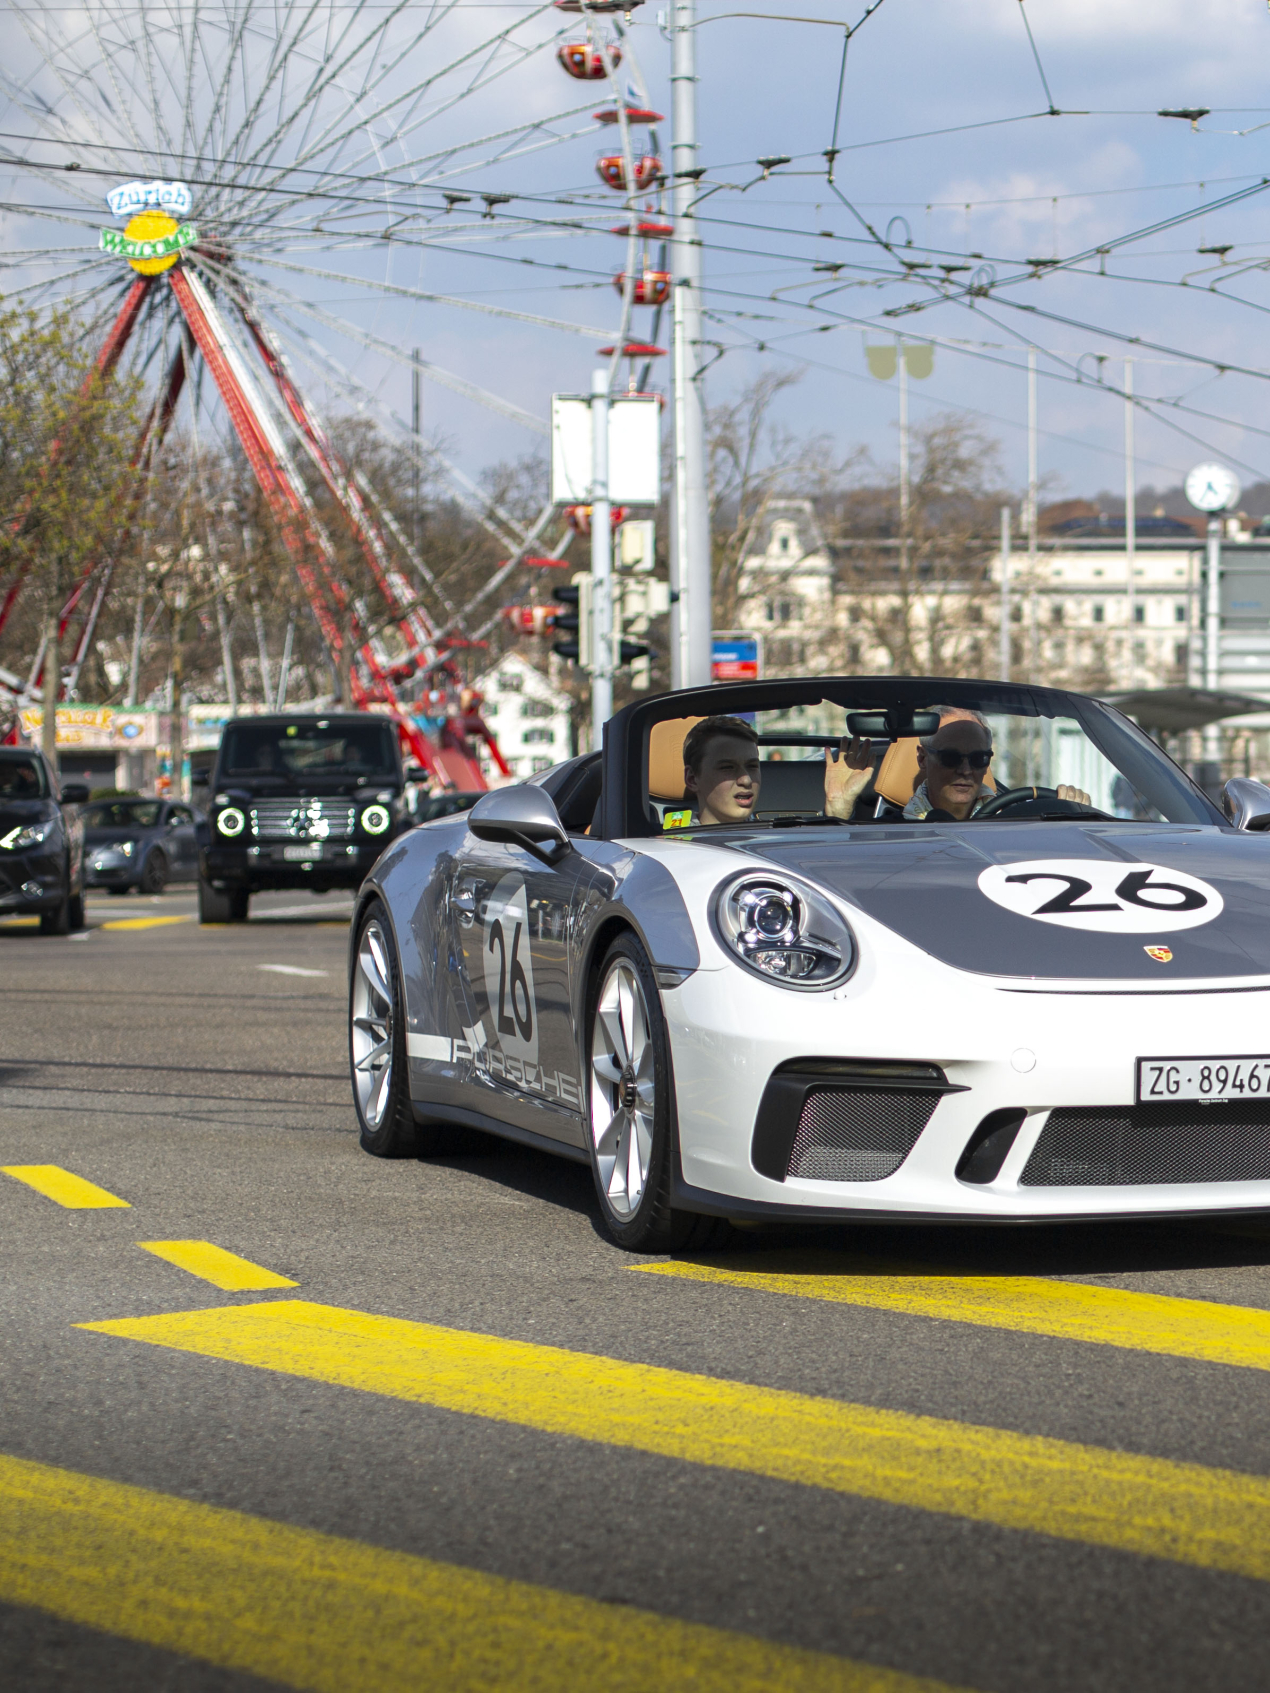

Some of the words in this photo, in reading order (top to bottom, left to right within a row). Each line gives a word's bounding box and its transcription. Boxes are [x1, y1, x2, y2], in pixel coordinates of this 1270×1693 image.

[101, 223, 197, 257] WELCOME
[670, 818, 683, 827] 21
[1005, 869, 1208, 915] 26
[489, 918, 533, 1043] 26
[452, 1038, 580, 1099] PORSCHE
